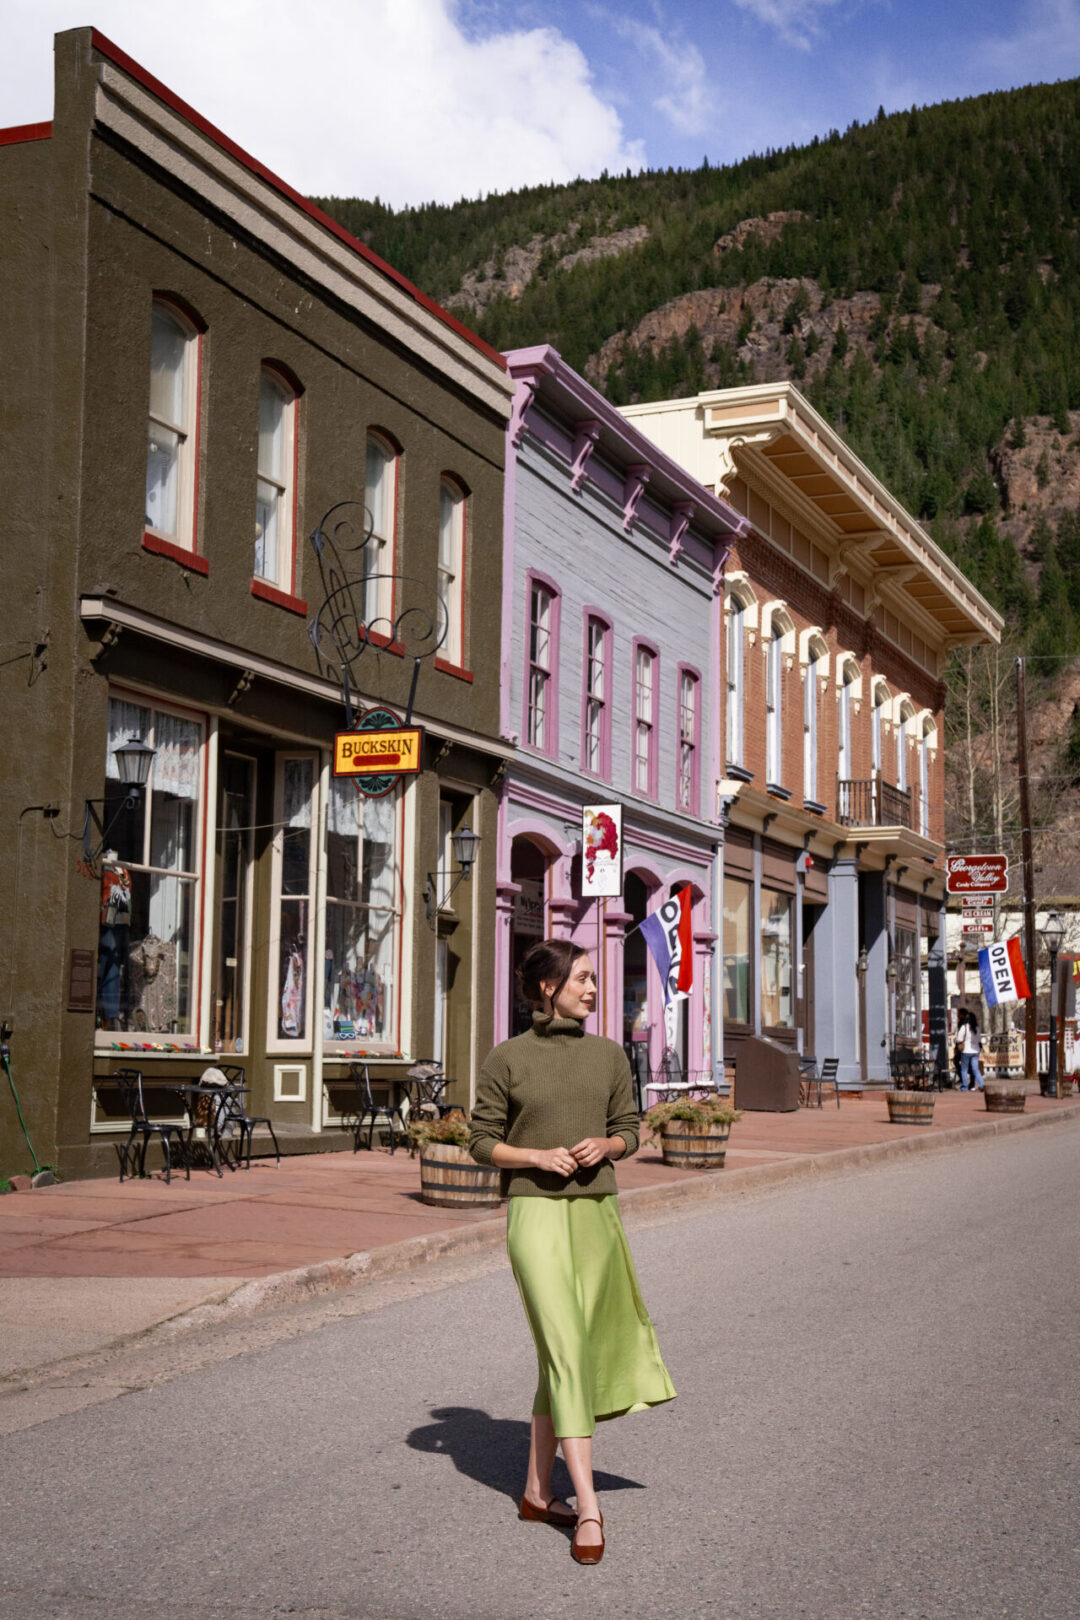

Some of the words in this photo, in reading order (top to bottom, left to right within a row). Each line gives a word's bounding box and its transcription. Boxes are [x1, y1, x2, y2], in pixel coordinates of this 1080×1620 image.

[342, 739, 413, 758] BUCKSKIN
[950, 858, 1002, 875] Georgetown
[970, 871, 1000, 885] Valley
[991, 946, 1012, 993] OPEN
